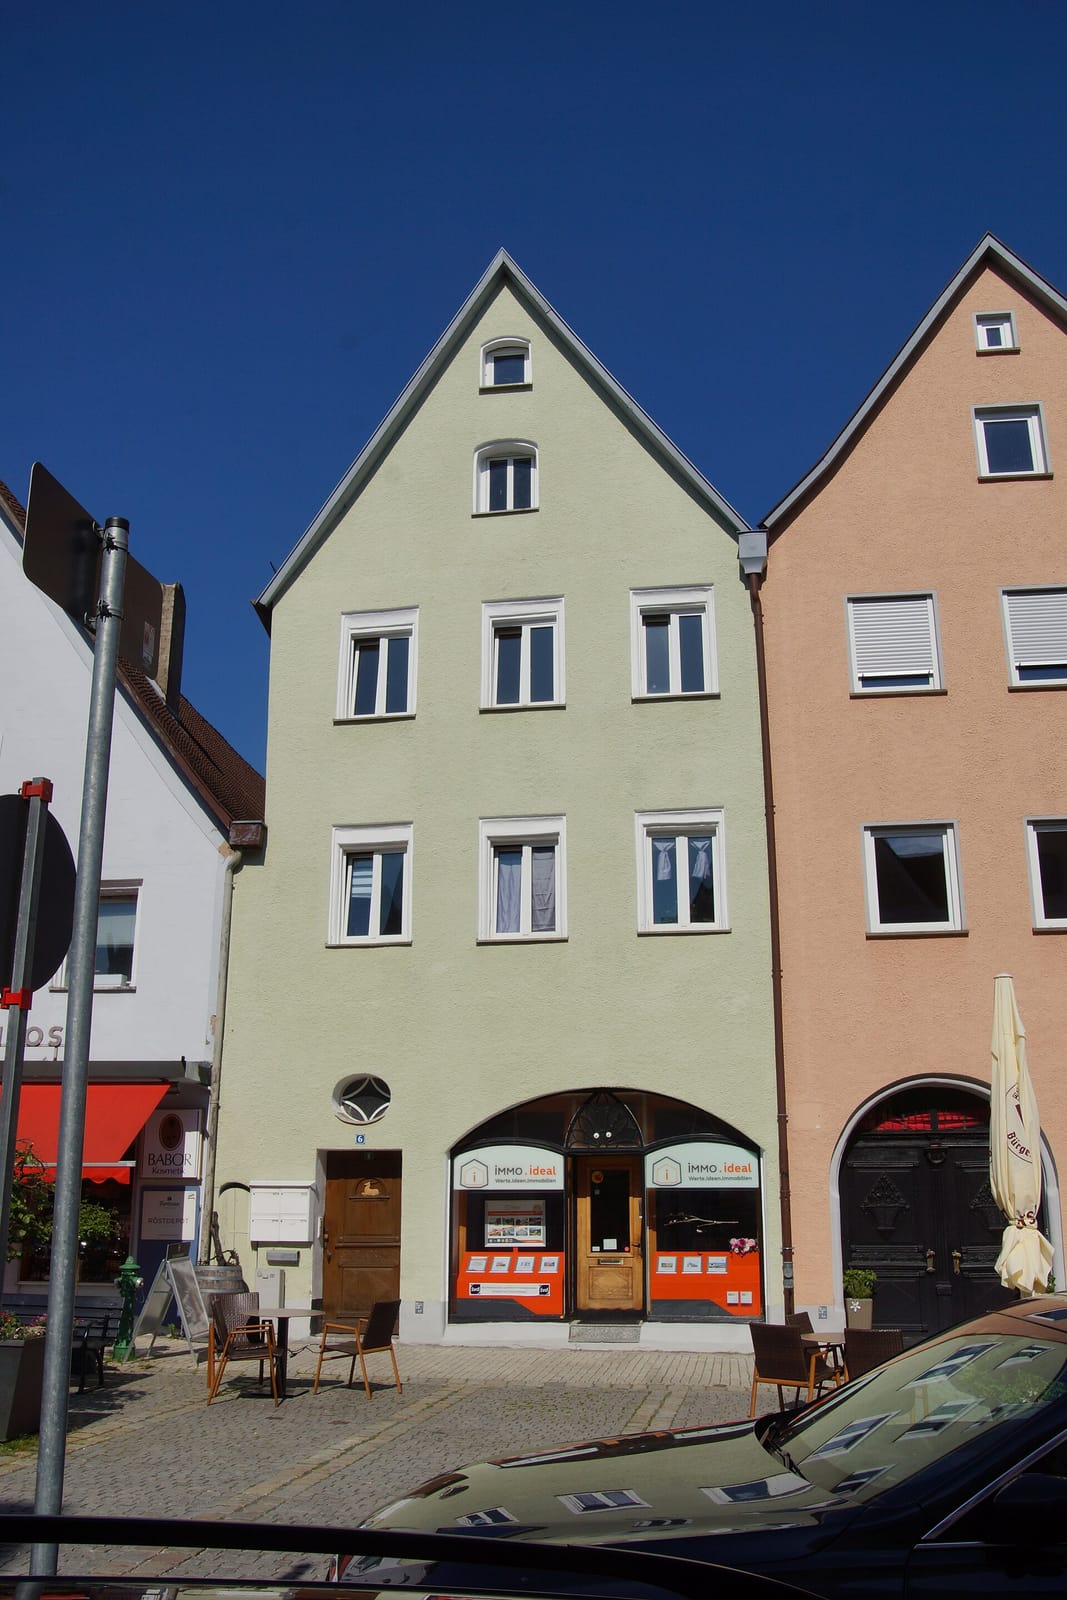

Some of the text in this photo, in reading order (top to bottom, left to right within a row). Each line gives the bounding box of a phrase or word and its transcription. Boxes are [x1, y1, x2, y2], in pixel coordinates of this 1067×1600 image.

[1006, 1131, 1032, 1157] Bürge
[148, 1153, 192, 1166] BABOR
[152, 1167, 186, 1175] Kosmetik
